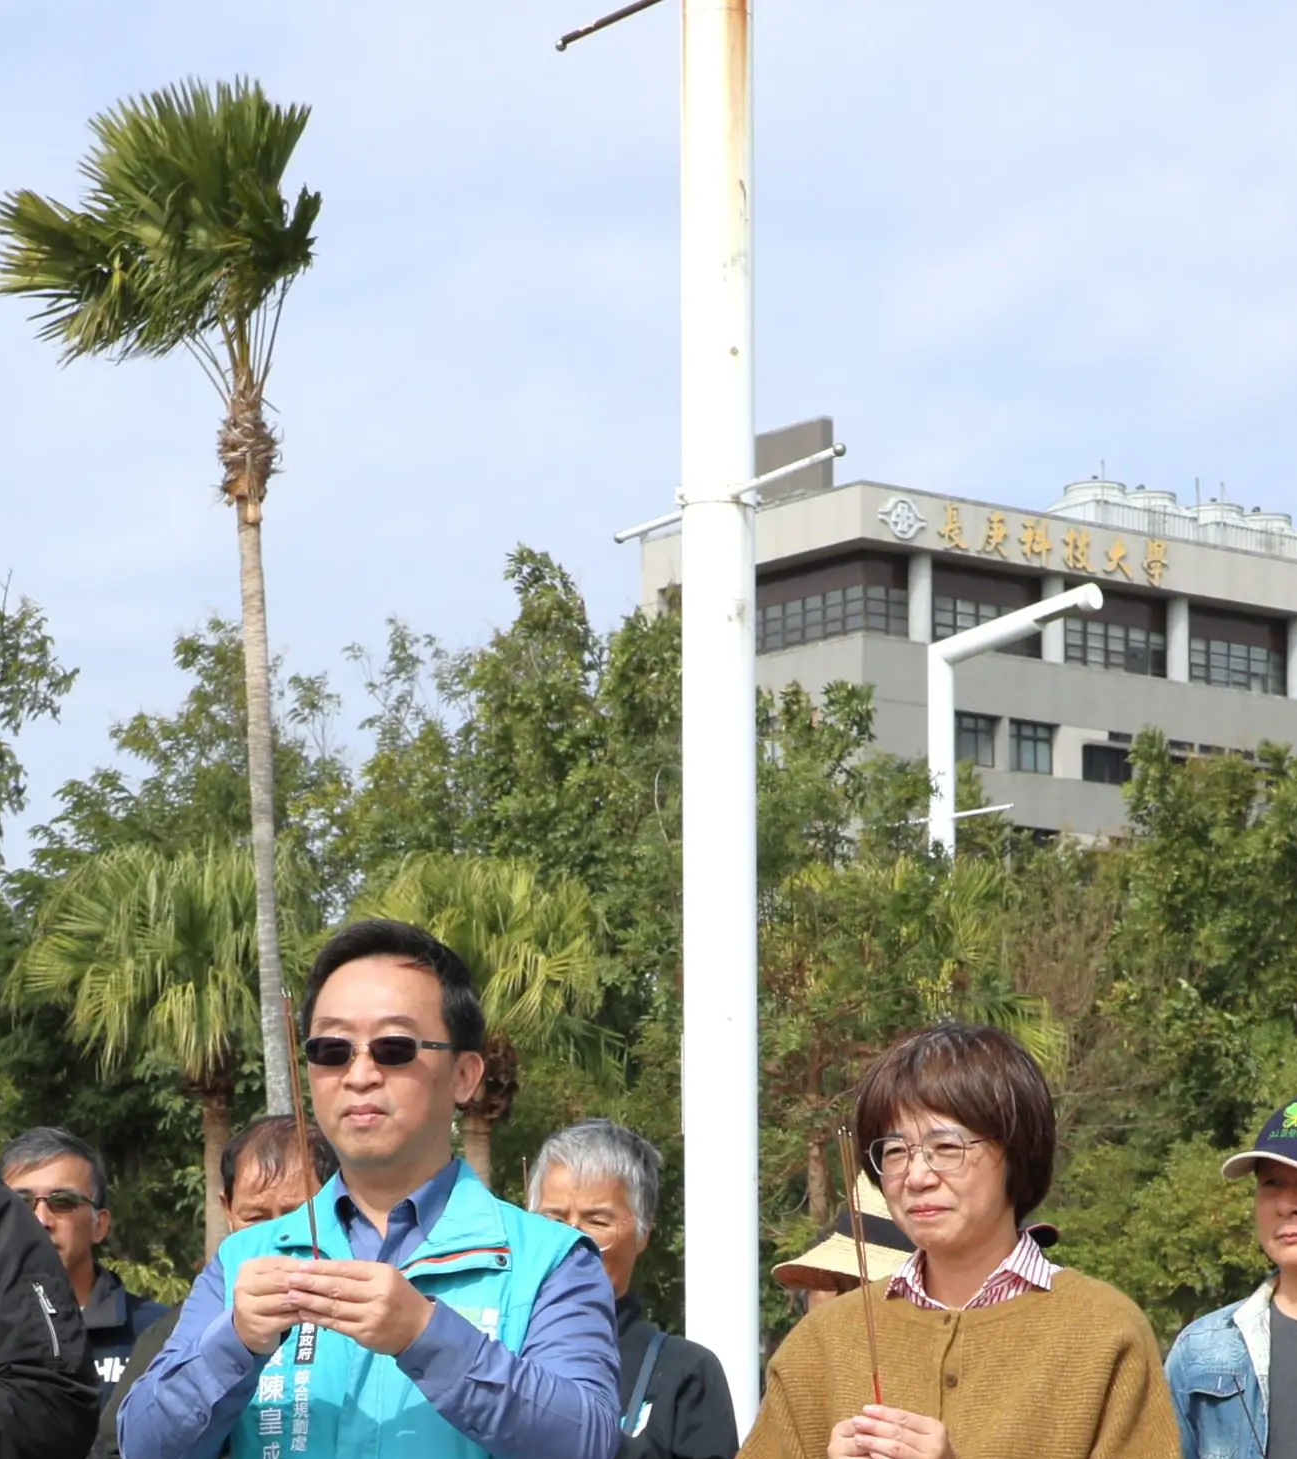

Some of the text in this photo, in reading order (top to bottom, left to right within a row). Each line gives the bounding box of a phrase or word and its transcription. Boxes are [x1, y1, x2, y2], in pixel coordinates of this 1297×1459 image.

[937, 503, 1168, 587] 長庚科技大學
